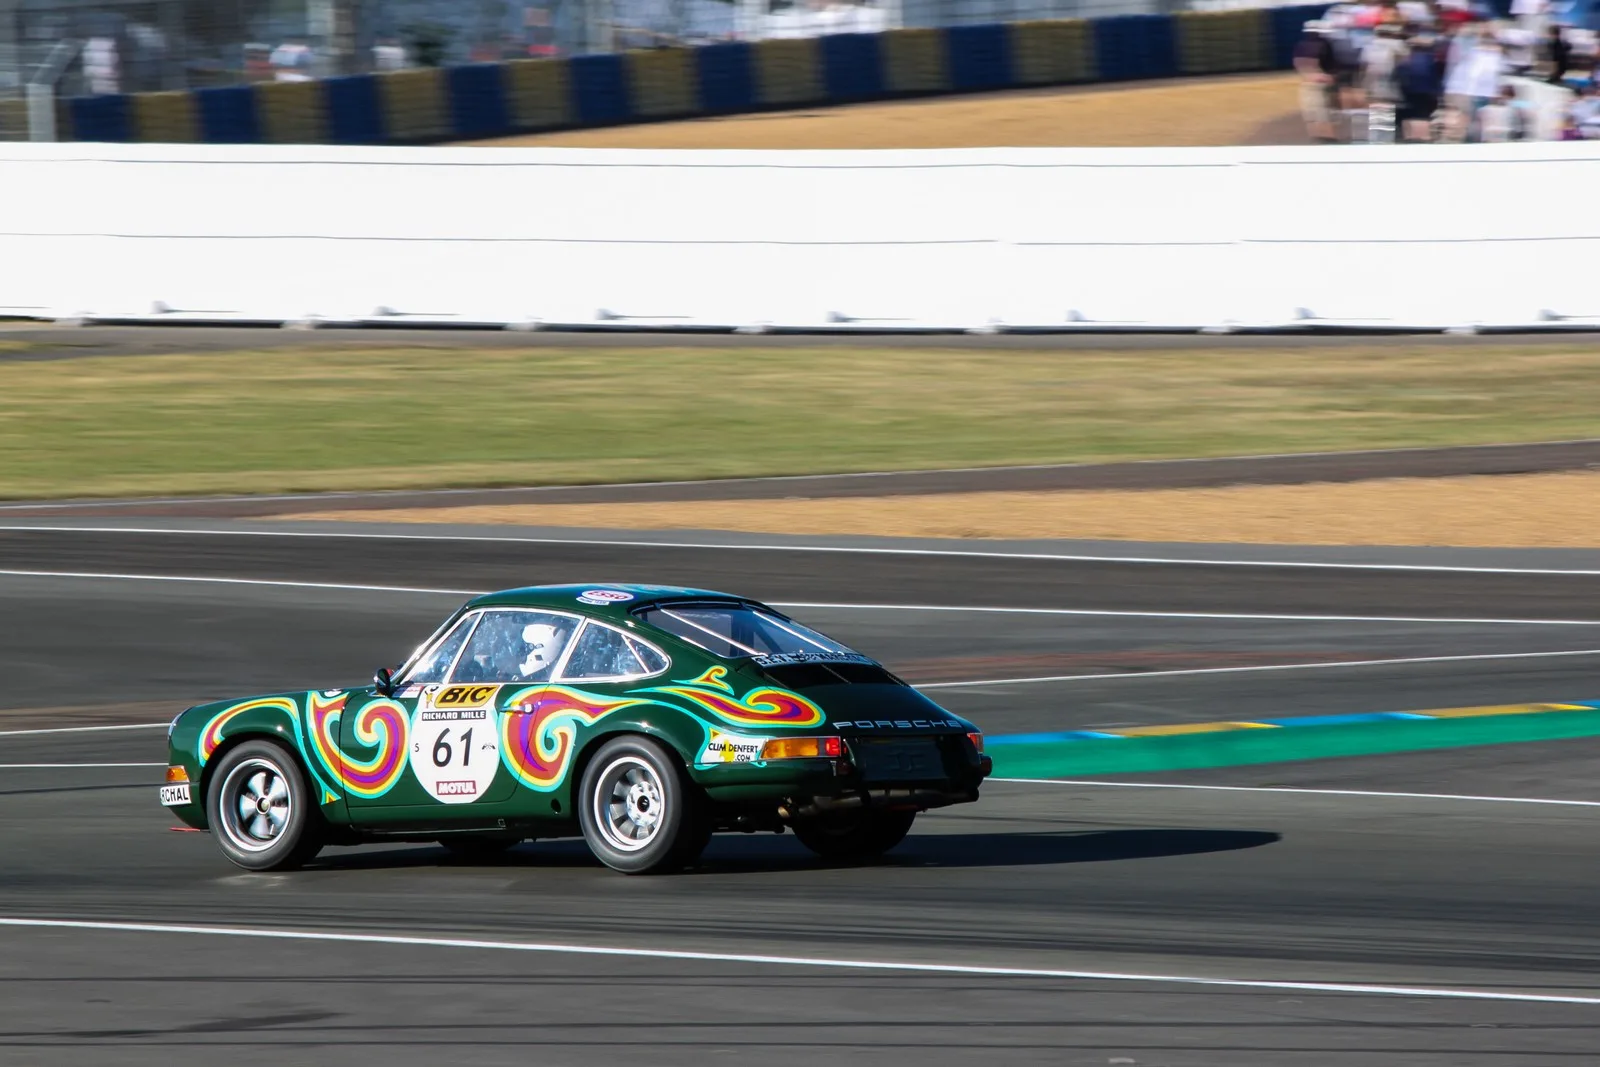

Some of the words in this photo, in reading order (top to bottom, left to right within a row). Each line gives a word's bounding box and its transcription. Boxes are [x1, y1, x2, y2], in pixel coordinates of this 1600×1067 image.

[422, 711, 458, 720] RICHARD
[461, 710, 485, 719] MILLE
[832, 719, 963, 730] PORSCHE
[432, 727, 473, 767] 61
[708, 742, 727, 752] CLIM
[728, 743, 758, 753] DENFERT
[438, 781, 475, 794] MOTUL
